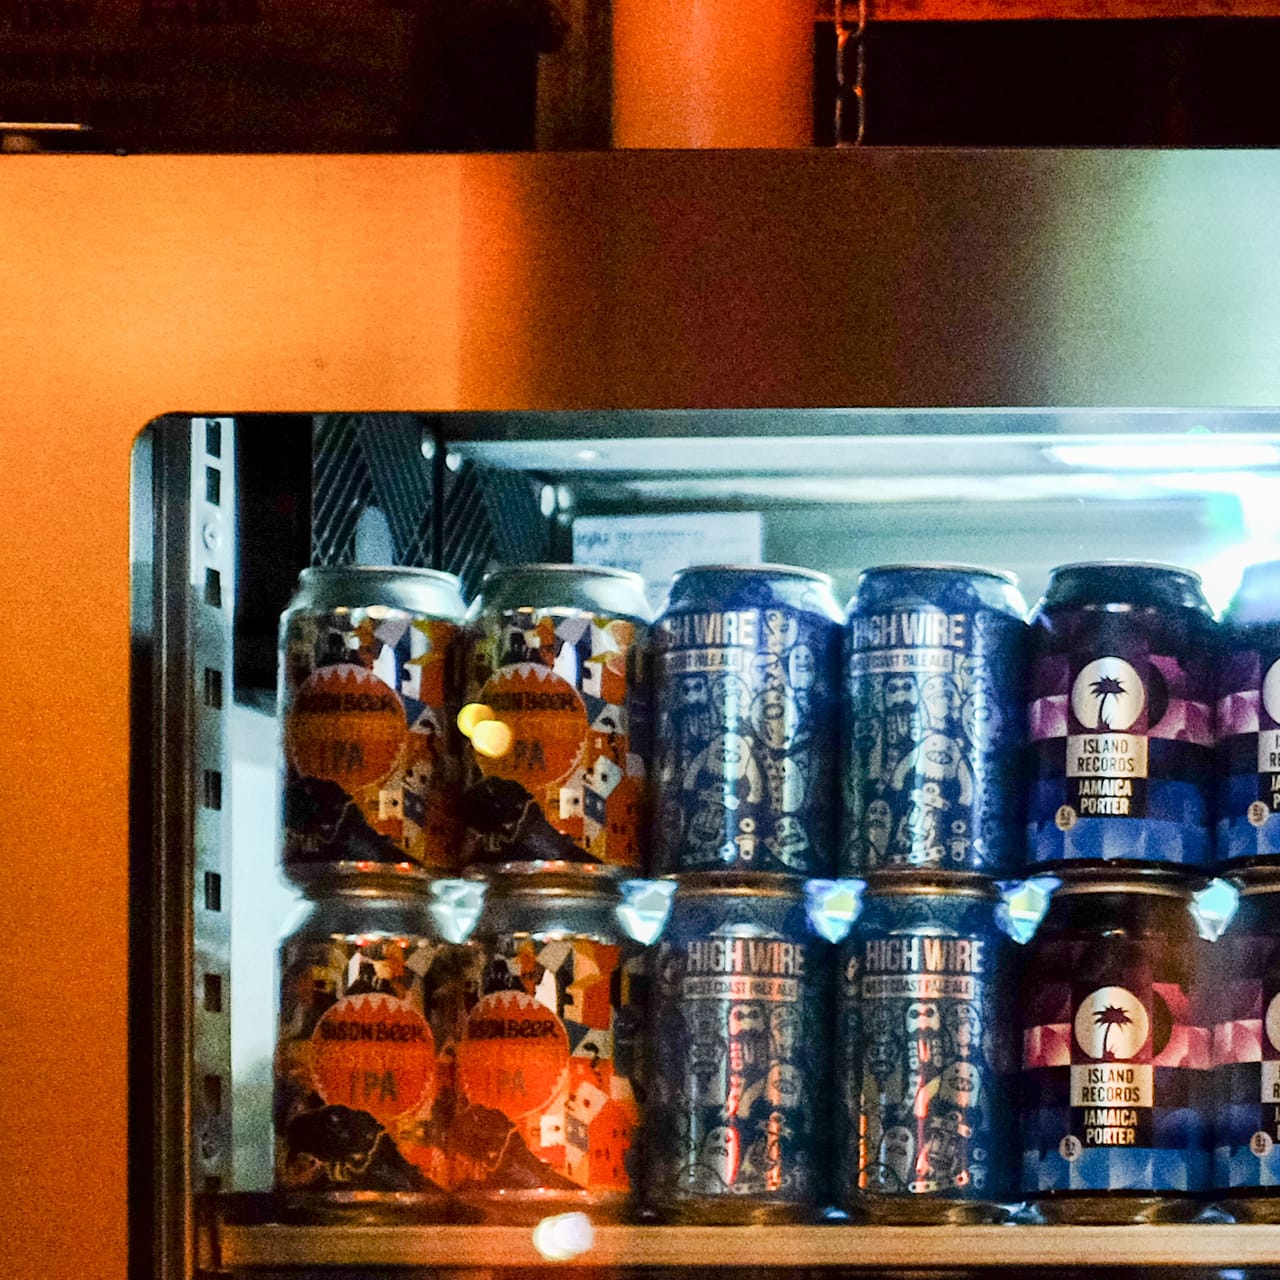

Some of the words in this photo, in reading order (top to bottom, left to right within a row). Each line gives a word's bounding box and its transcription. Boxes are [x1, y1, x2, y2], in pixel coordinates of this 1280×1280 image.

[697, 608, 758, 646] WIRE
[901, 611, 966, 648] WIRE
[1083, 739, 1128, 755] ISLAND
[1078, 757, 1135, 772] RECORDS
[1079, 779, 1132, 796] JAMAICA
[1080, 797, 1130, 815] PORTER
[687, 940, 744, 974] HIGH
[748, 940, 806, 976] WIRE
[866, 940, 921, 973] HIGH
[924, 940, 985, 974] WIRE
[1088, 1068, 1134, 1084] ISLAND
[1082, 1086, 1140, 1102] RECORDS
[1084, 1108, 1138, 1126] JAMAICA
[1086, 1128, 1136, 1145] PORTER
